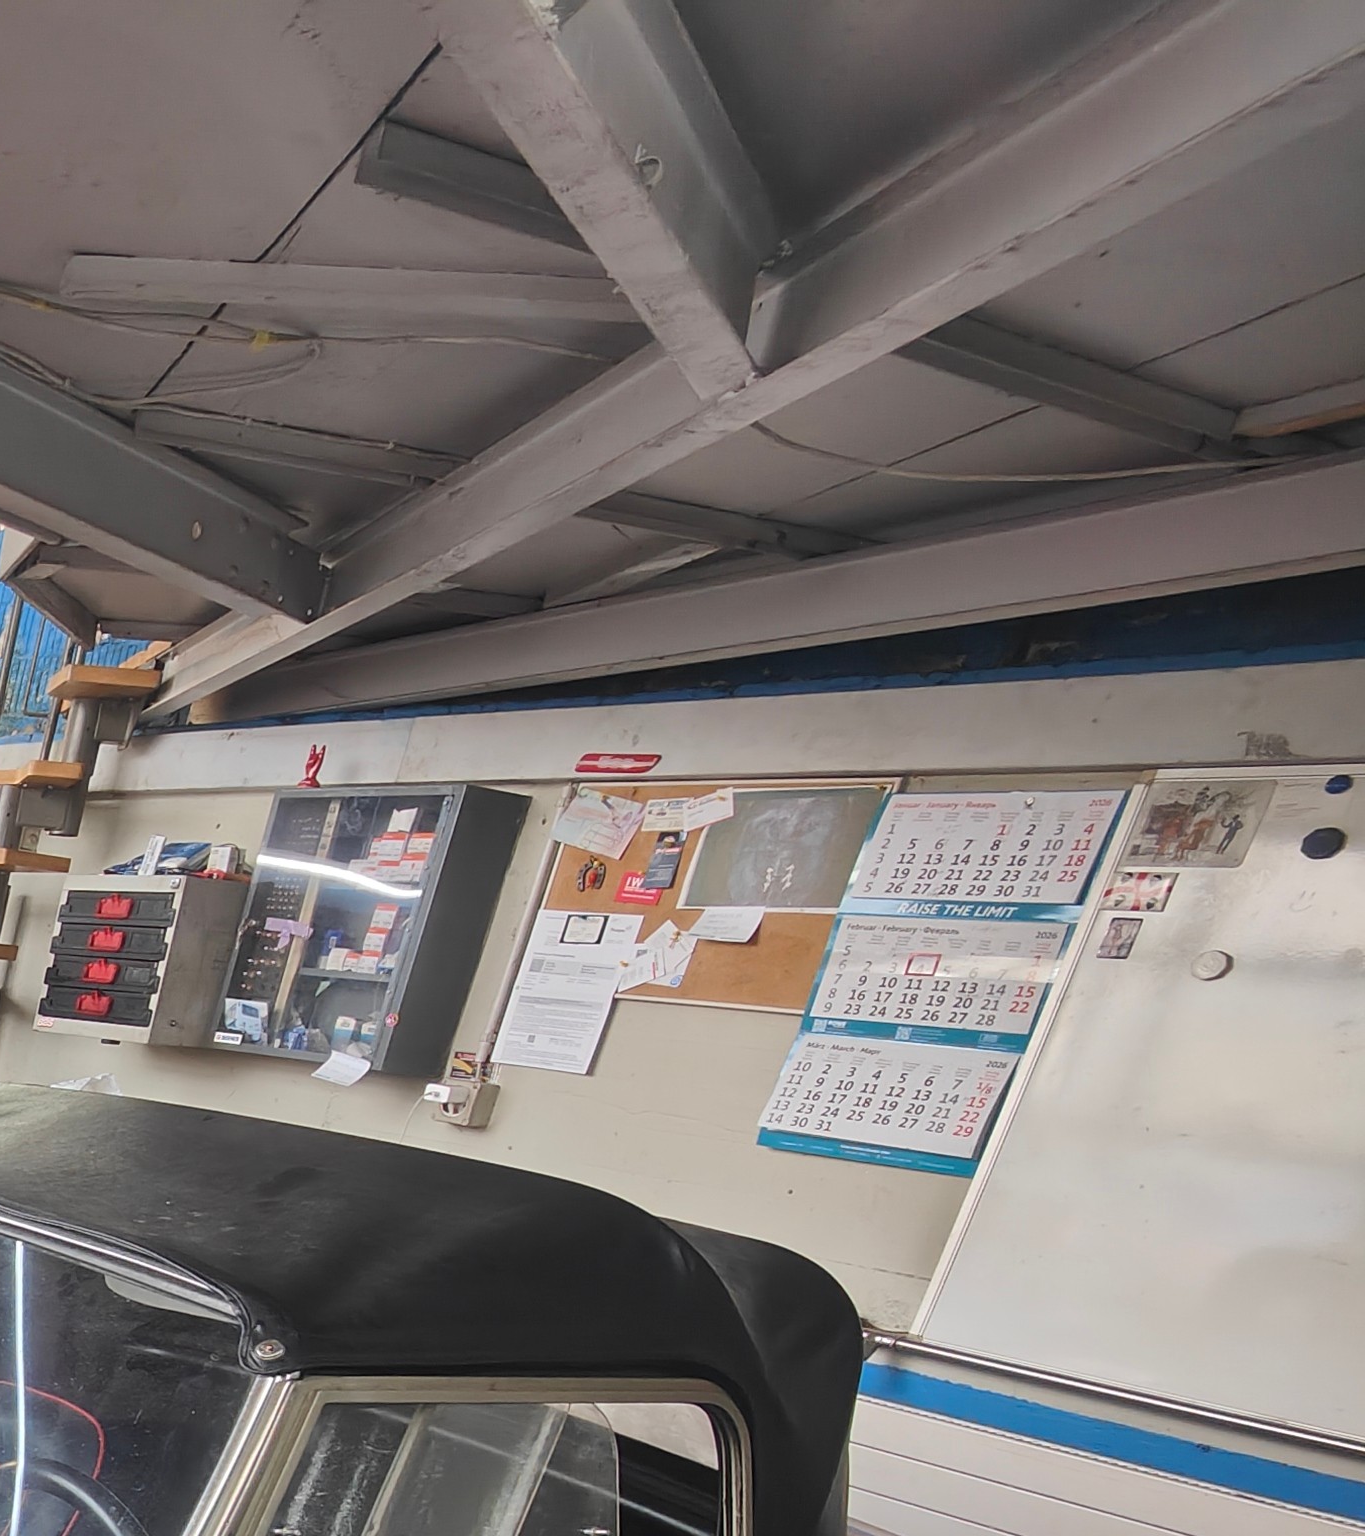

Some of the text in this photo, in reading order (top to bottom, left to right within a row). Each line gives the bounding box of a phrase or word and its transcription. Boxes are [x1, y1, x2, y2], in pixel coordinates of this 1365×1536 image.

[926, 802, 959, 811] January
[887, 823, 1094, 836] 1 1 2 3 4
[881, 838, 1091, 851] 2 5 6 7 8 9 10 11
[876, 853, 1086, 867] 3 12 13 14 15 16 17 18
[870, 867, 1078, 882] 4 19 20 21 22 23 24 25
[864, 881, 1041, 897] 5 26 27 28 29 30 31
[897, 903, 1018, 918] RAISE THE LIMIT
[847, 923, 918, 935] Februar February
[1035, 931, 1058, 939] 2026
[842, 945, 1041, 967] 5 1
[839, 959, 848, 969] 6
[864, 961, 873, 971] 2
[889, 962, 898, 973] 3
[967, 968, 979, 980] 6
[834, 973, 1036, 998] 7 9 10 11 12 13 14 15
[828, 988, 1030, 1013] 8 16 17 18 19 20 21 22
[823, 1002, 996, 1026] 9 23 24 25 26 27 28
[830, 1044, 855, 1052] March
[986, 1060, 1008, 1068] 2026
[793, 1061, 993, 1094] 10 2 3 4 5 6 7 1/8
[786, 1074, 988, 1109] 11 9 10 11 12 13 14 15
[779, 1087, 980, 1123] 12 16 17 18 19 20 21 22
[766, 1113, 832, 1132] 14 30 31
[772, 1100, 973, 1137] 13 23 24 25 26 27 28 29
